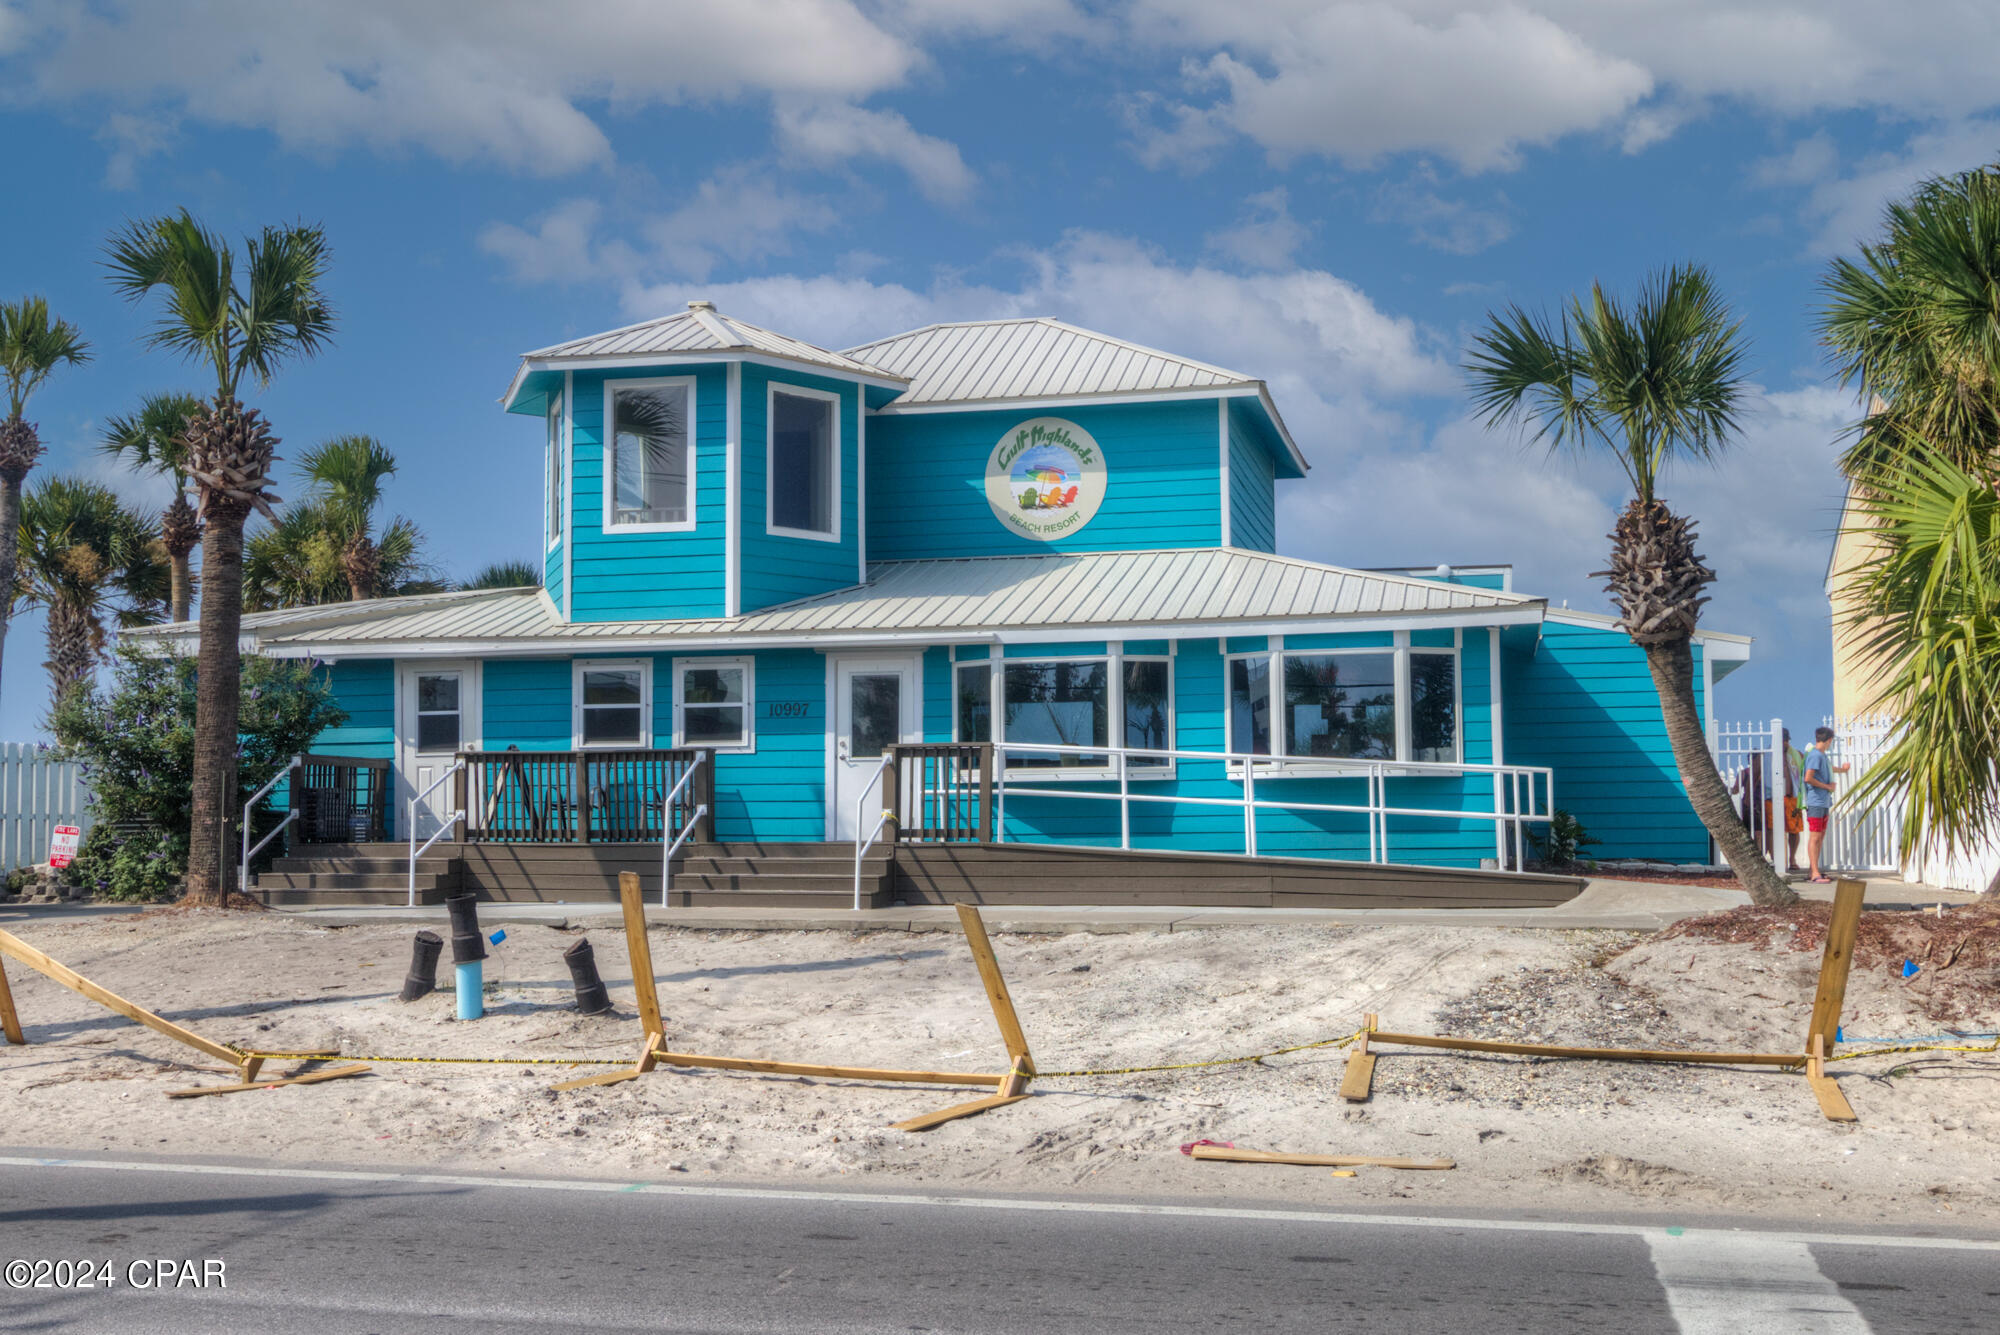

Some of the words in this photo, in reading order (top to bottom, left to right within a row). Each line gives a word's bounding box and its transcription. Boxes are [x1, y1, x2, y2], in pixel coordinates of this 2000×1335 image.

[998, 429, 1029, 471] Gulf
[1030, 425, 1092, 465] Highlands
[1009, 513, 1041, 533] BEACH
[1043, 510, 1081, 534] RESORT
[769, 702, 809, 717] 10997
[61, 836, 70, 844] NO
[51, 844, 77, 855] PARKING
